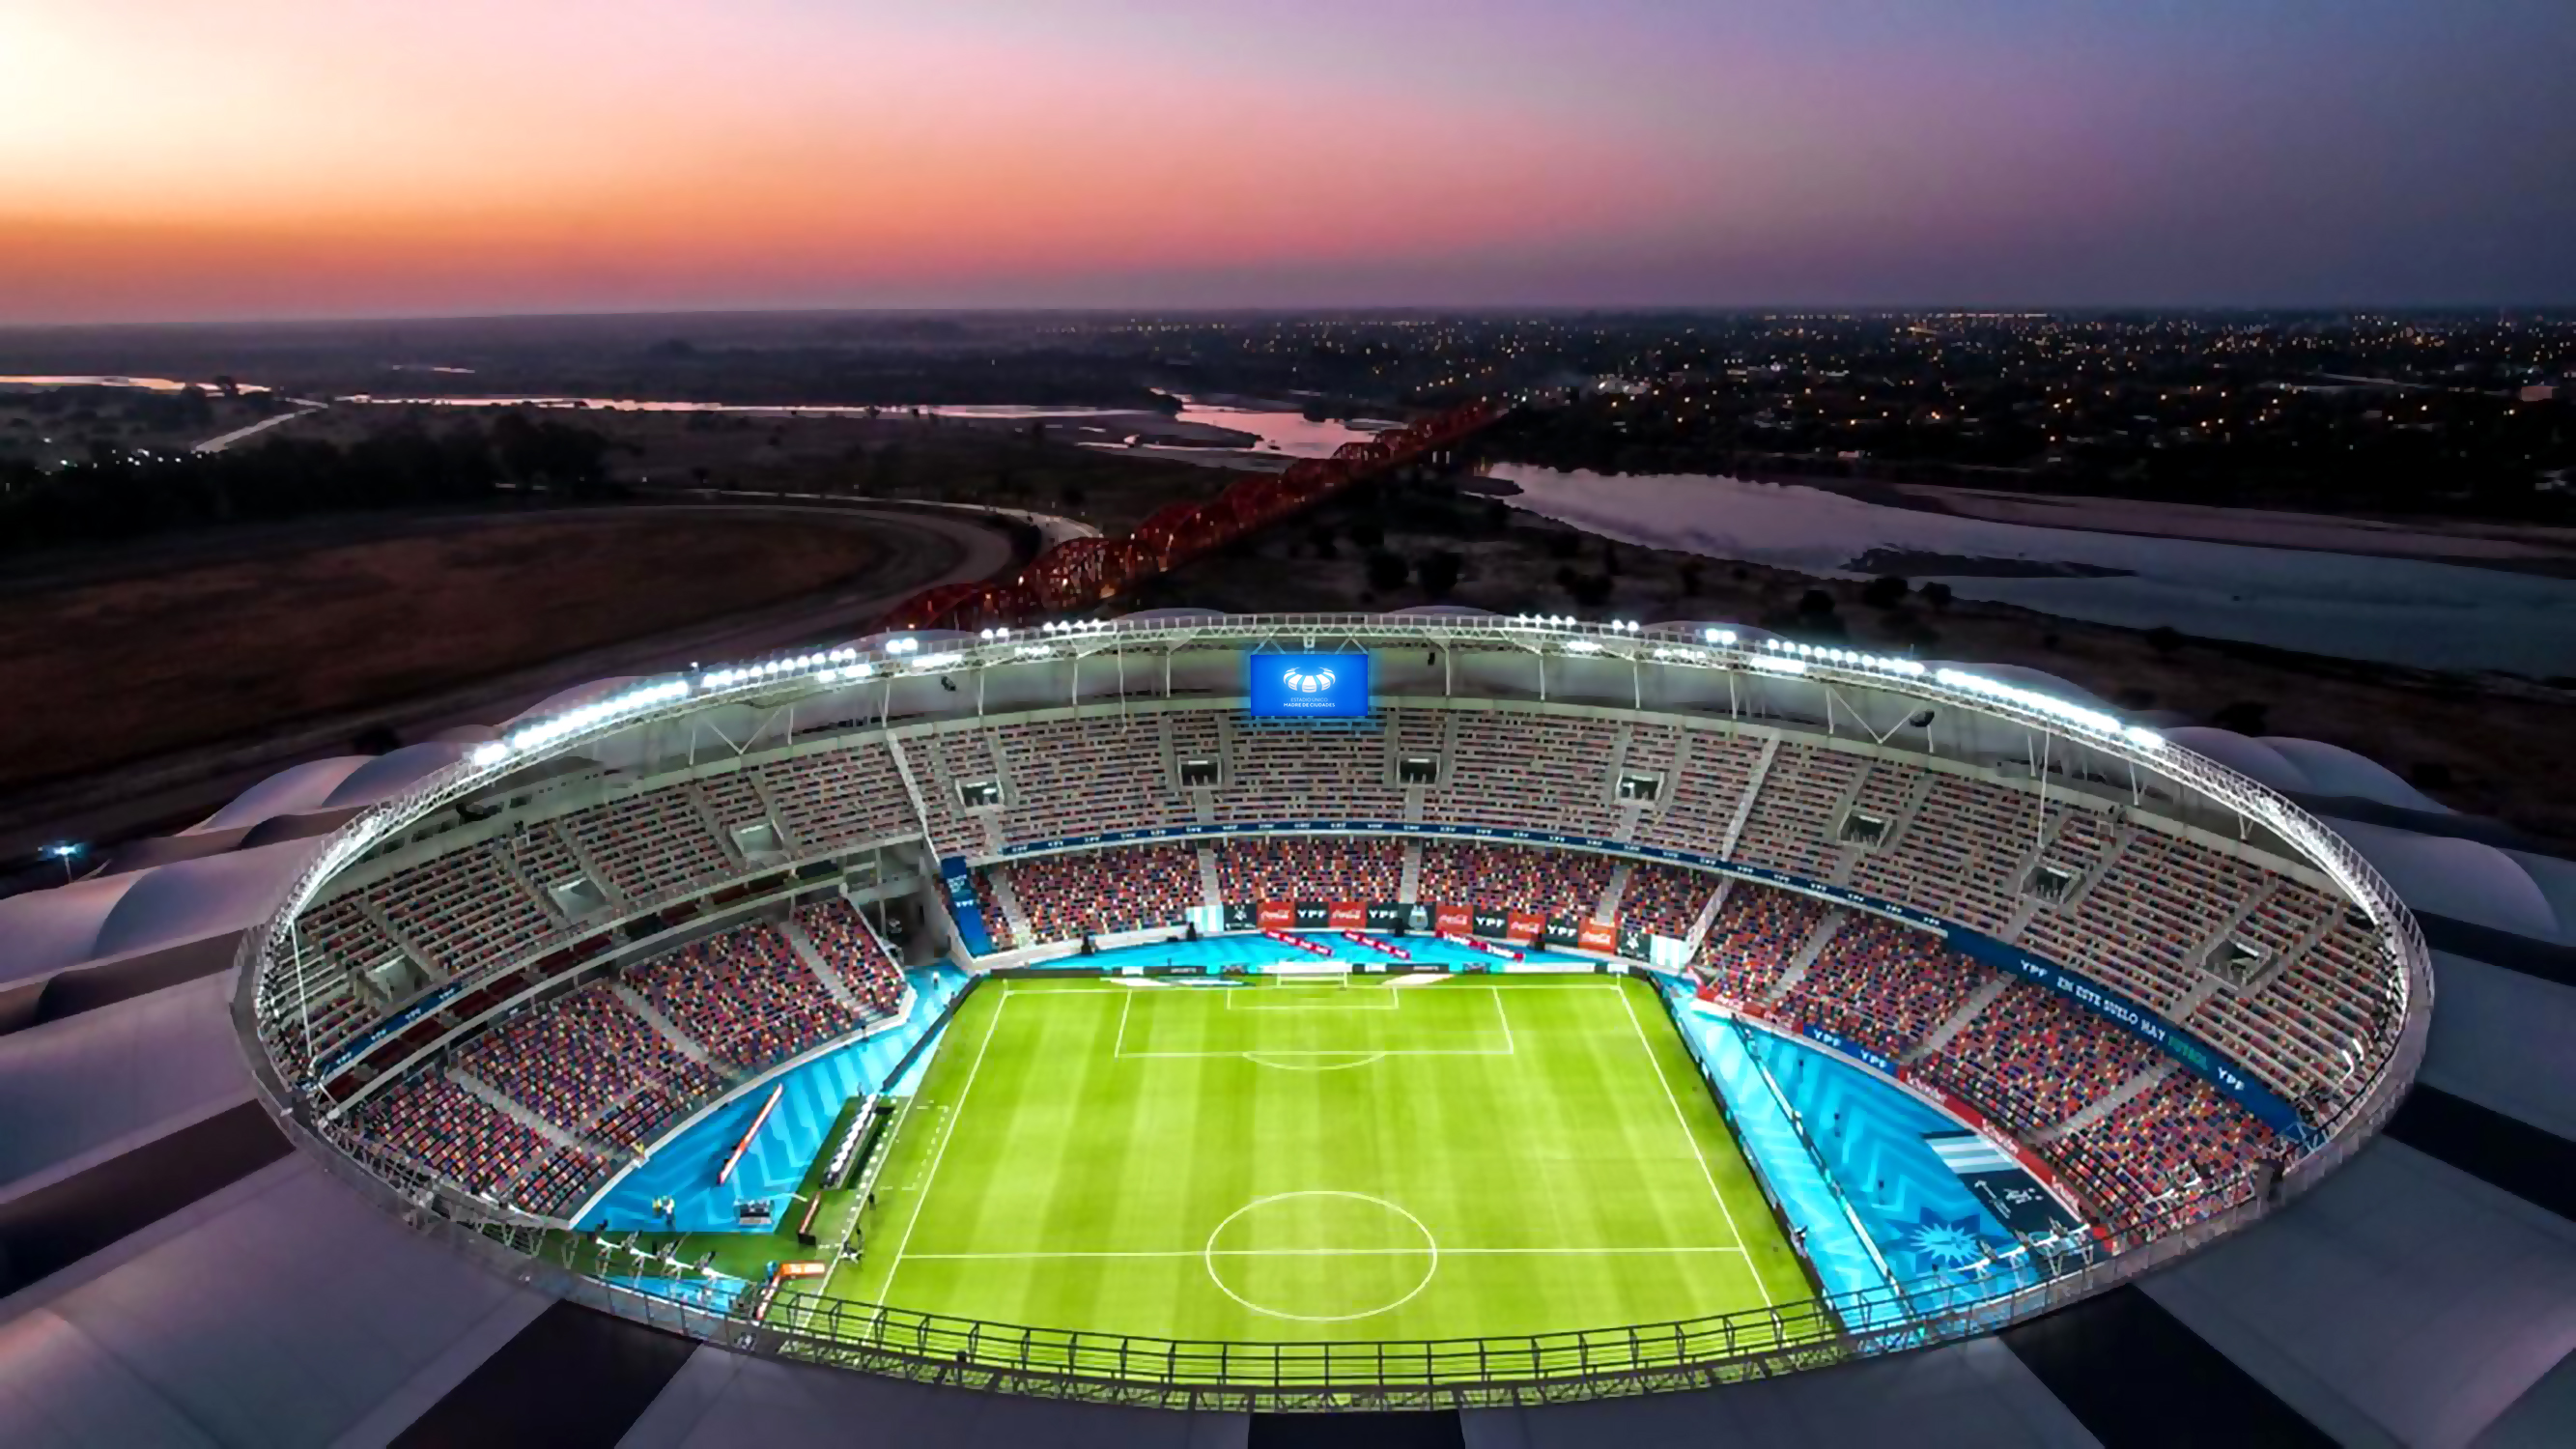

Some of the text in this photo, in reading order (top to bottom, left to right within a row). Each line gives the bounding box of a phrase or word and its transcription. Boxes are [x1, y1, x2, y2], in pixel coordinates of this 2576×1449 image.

[1297, 909, 1326, 919] YPF
[1369, 909, 1398, 920] YPF
[1476, 917, 1505, 928] YPF
[1547, 924, 1577, 937] YPF
